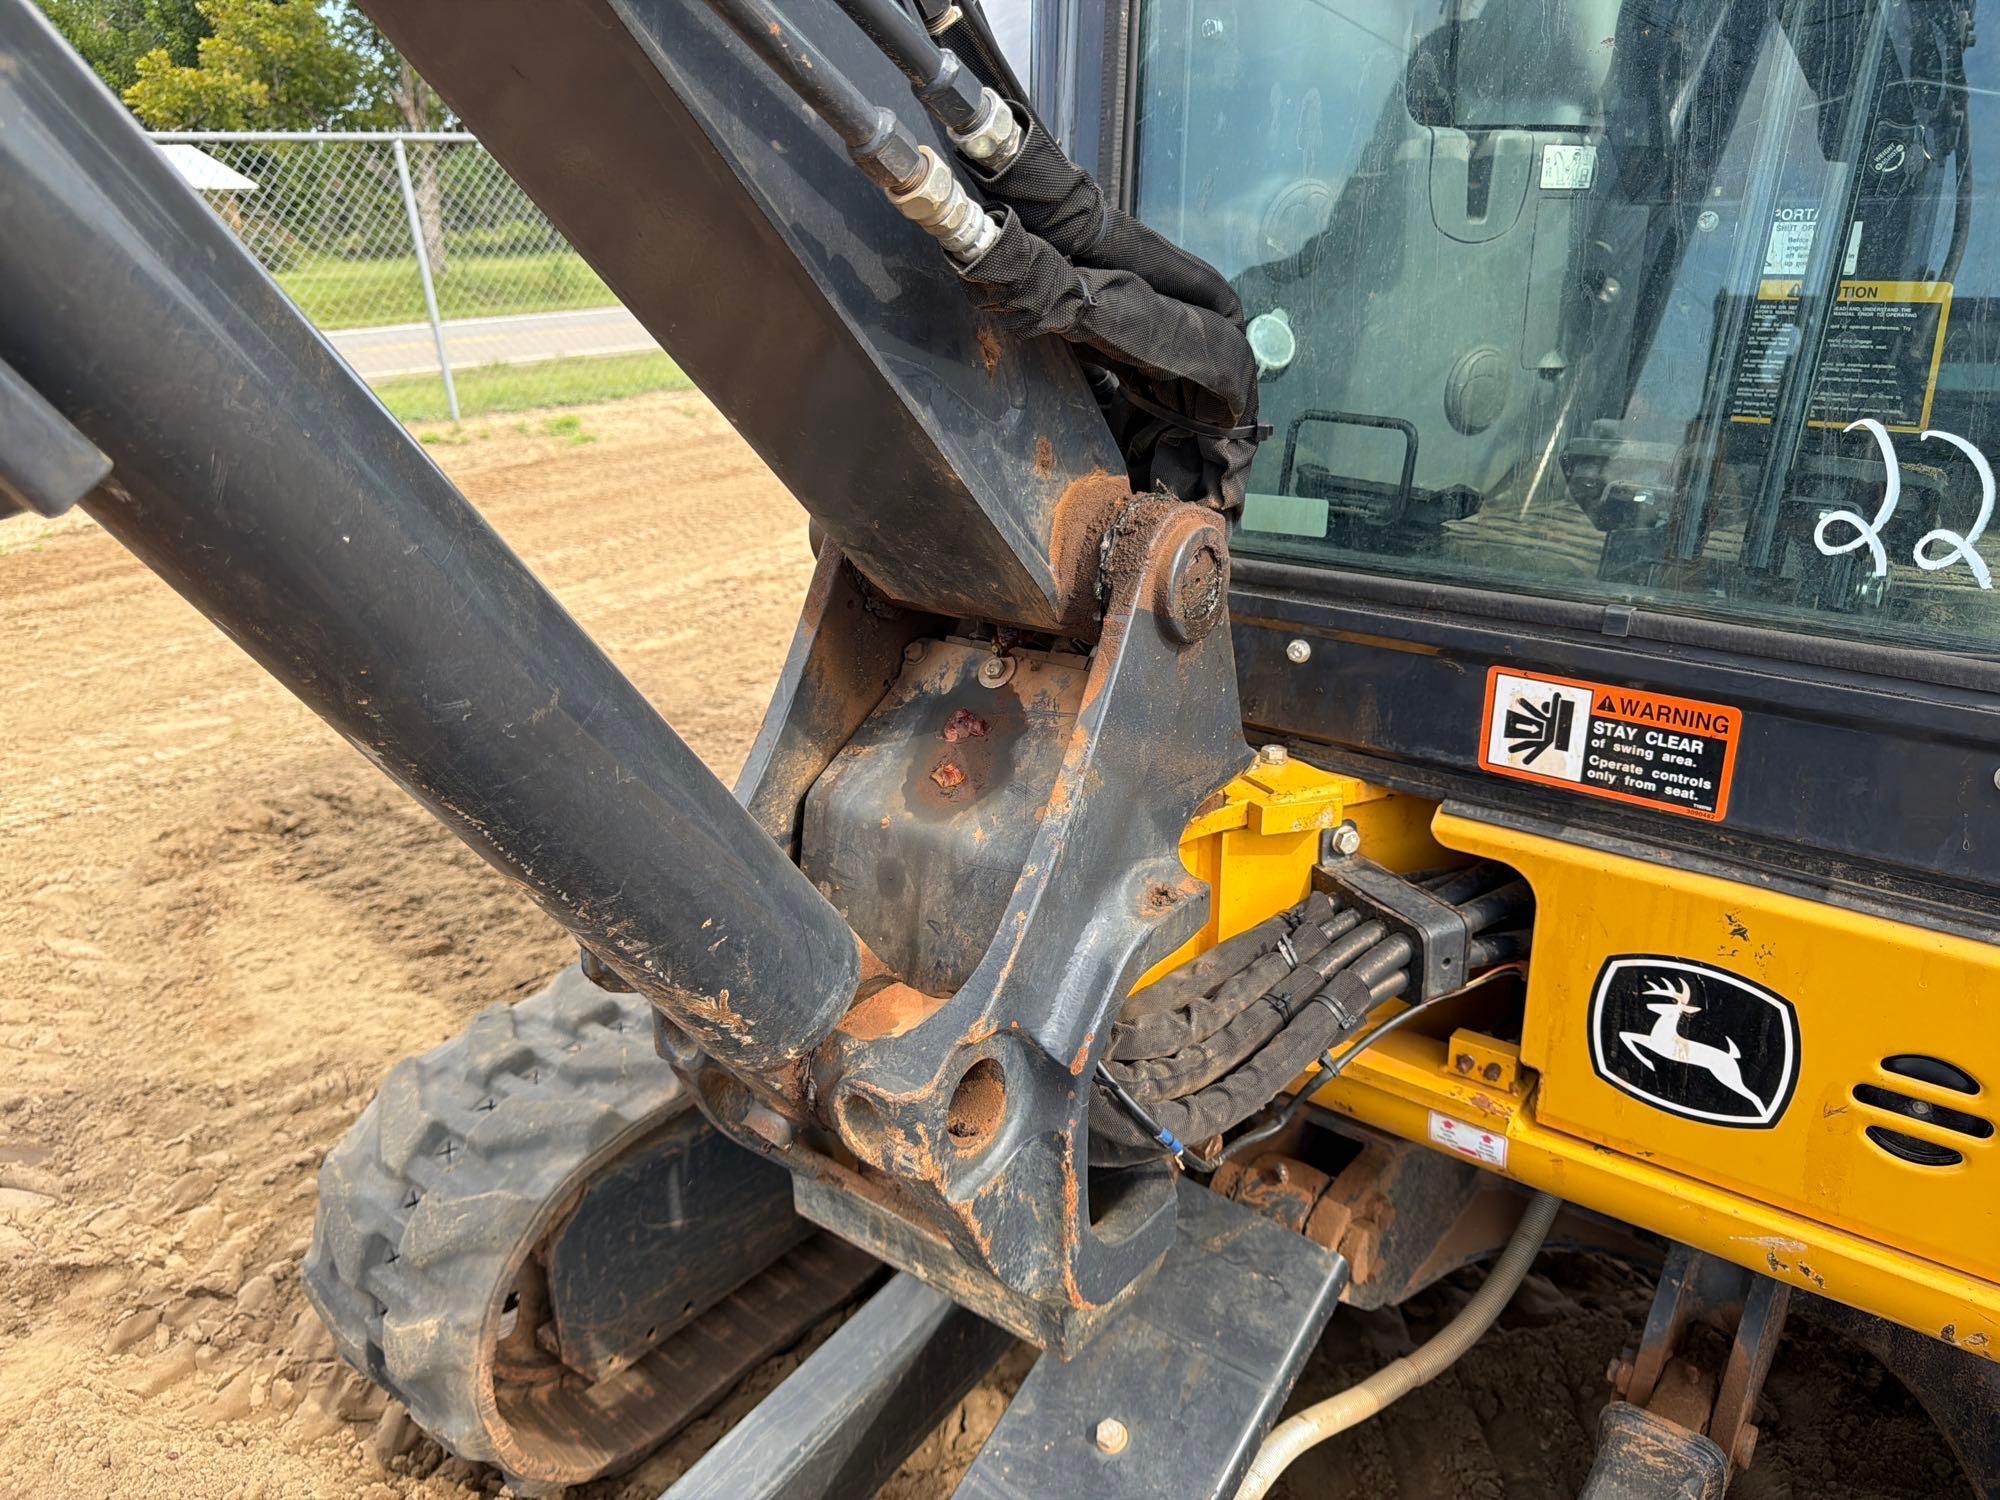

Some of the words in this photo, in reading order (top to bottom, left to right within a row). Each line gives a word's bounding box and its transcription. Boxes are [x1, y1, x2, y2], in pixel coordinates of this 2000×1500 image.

[1874, 142, 1895, 162] WEIGHT
[1776, 224, 1797, 232] SHUT
[1841, 286, 1878, 298] TION
[1620, 697, 1730, 734] WARNING
[1593, 721, 1638, 741] STAY
[1645, 731, 1704, 754] CLEAR
[1591, 738, 1606, 749] of
[1613, 742, 1654, 761] swing
[1661, 752, 1697, 768] area.
[1586, 769, 1617, 785] only
[1624, 775, 1657, 792] from
[1664, 786, 1699, 801] seat.
[1651, 769, 1712, 790] controls
